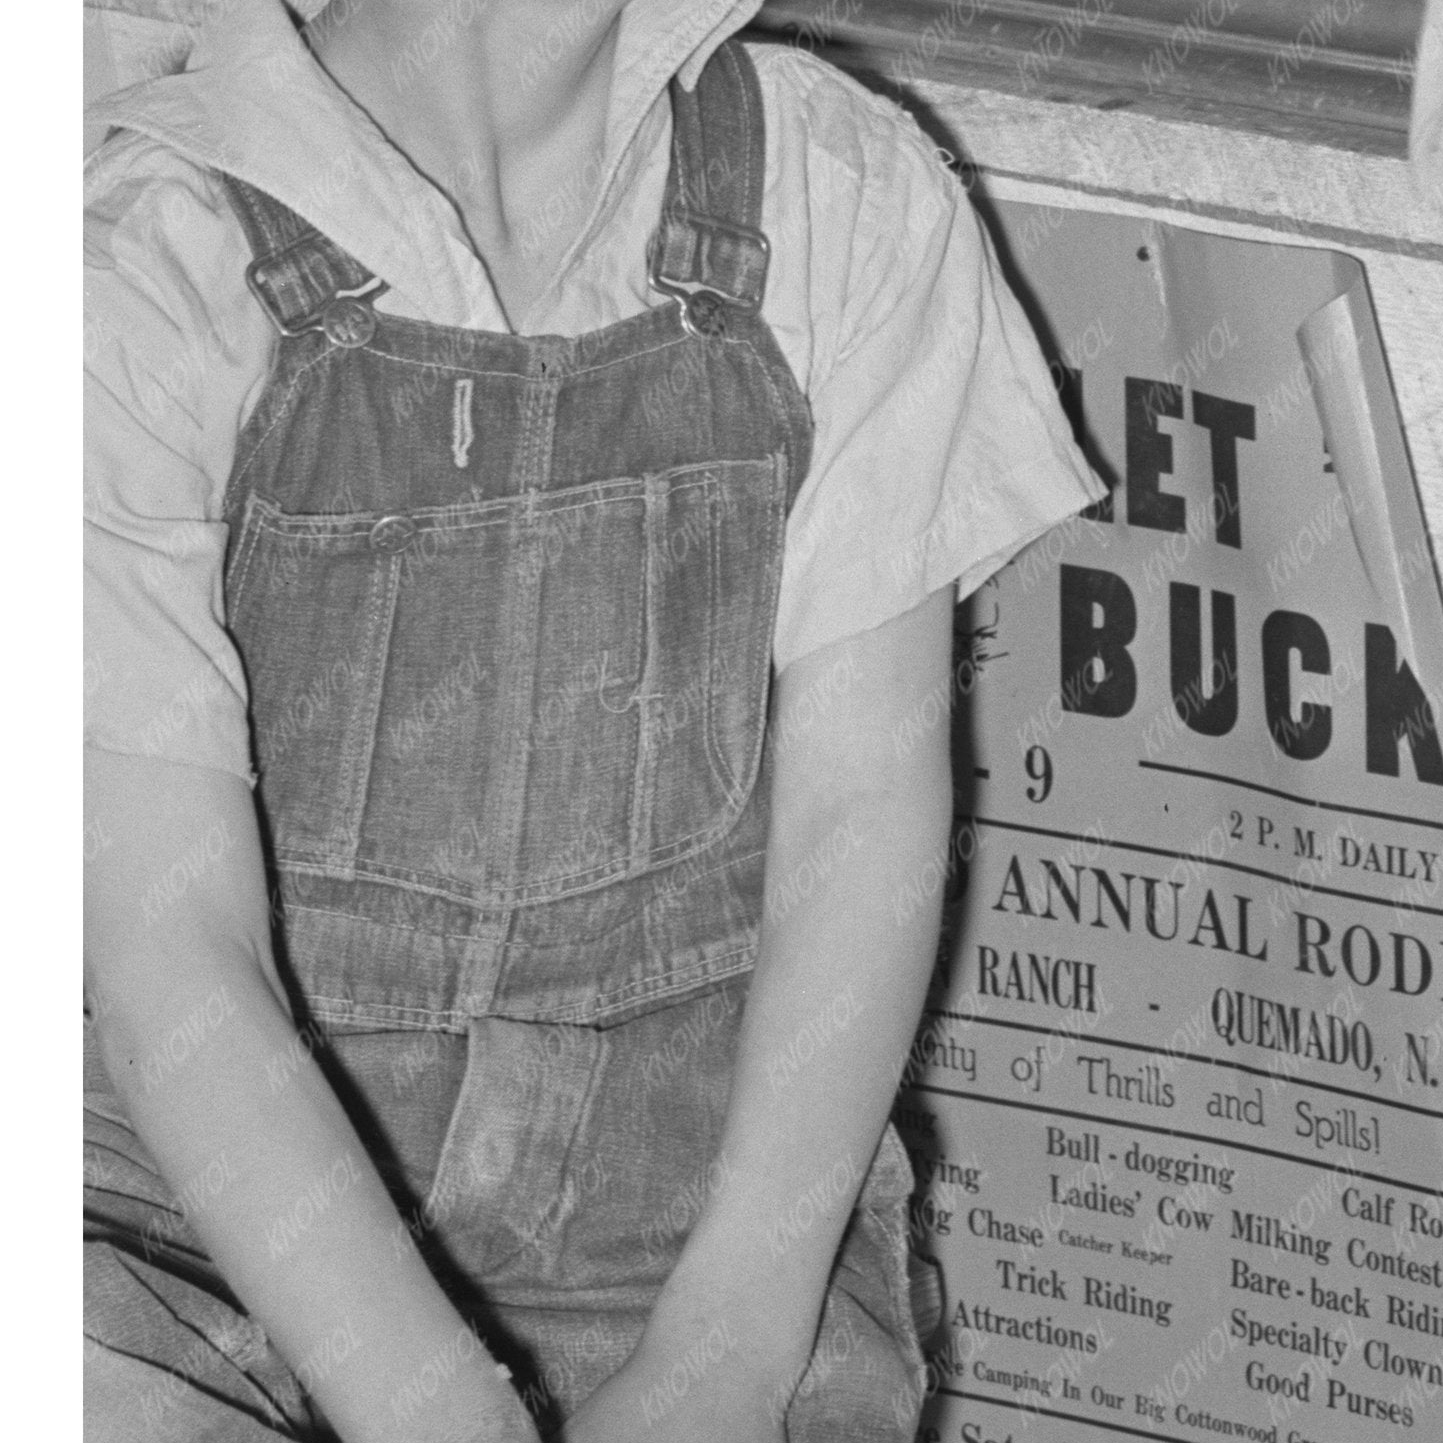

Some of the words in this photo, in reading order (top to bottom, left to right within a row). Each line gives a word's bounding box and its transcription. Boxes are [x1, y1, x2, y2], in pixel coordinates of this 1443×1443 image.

[1023, 743, 1054, 804] 9
[1338, 835, 1440, 884] DAILY
[991, 852, 1270, 963] ANNUAL
[976, 944, 1098, 1014] RANCH
[1211, 985, 1382, 1083] QUEMADO,
[1077, 1055, 1177, 1108] Thrills
[1206, 1086, 1267, 1127] and
[1294, 1100, 1382, 1154] Spills!
[1340, 1186, 1396, 1228] Calf
[995, 1259, 1068, 1303] Trick
[1082, 1276, 1174, 1327] Riding
